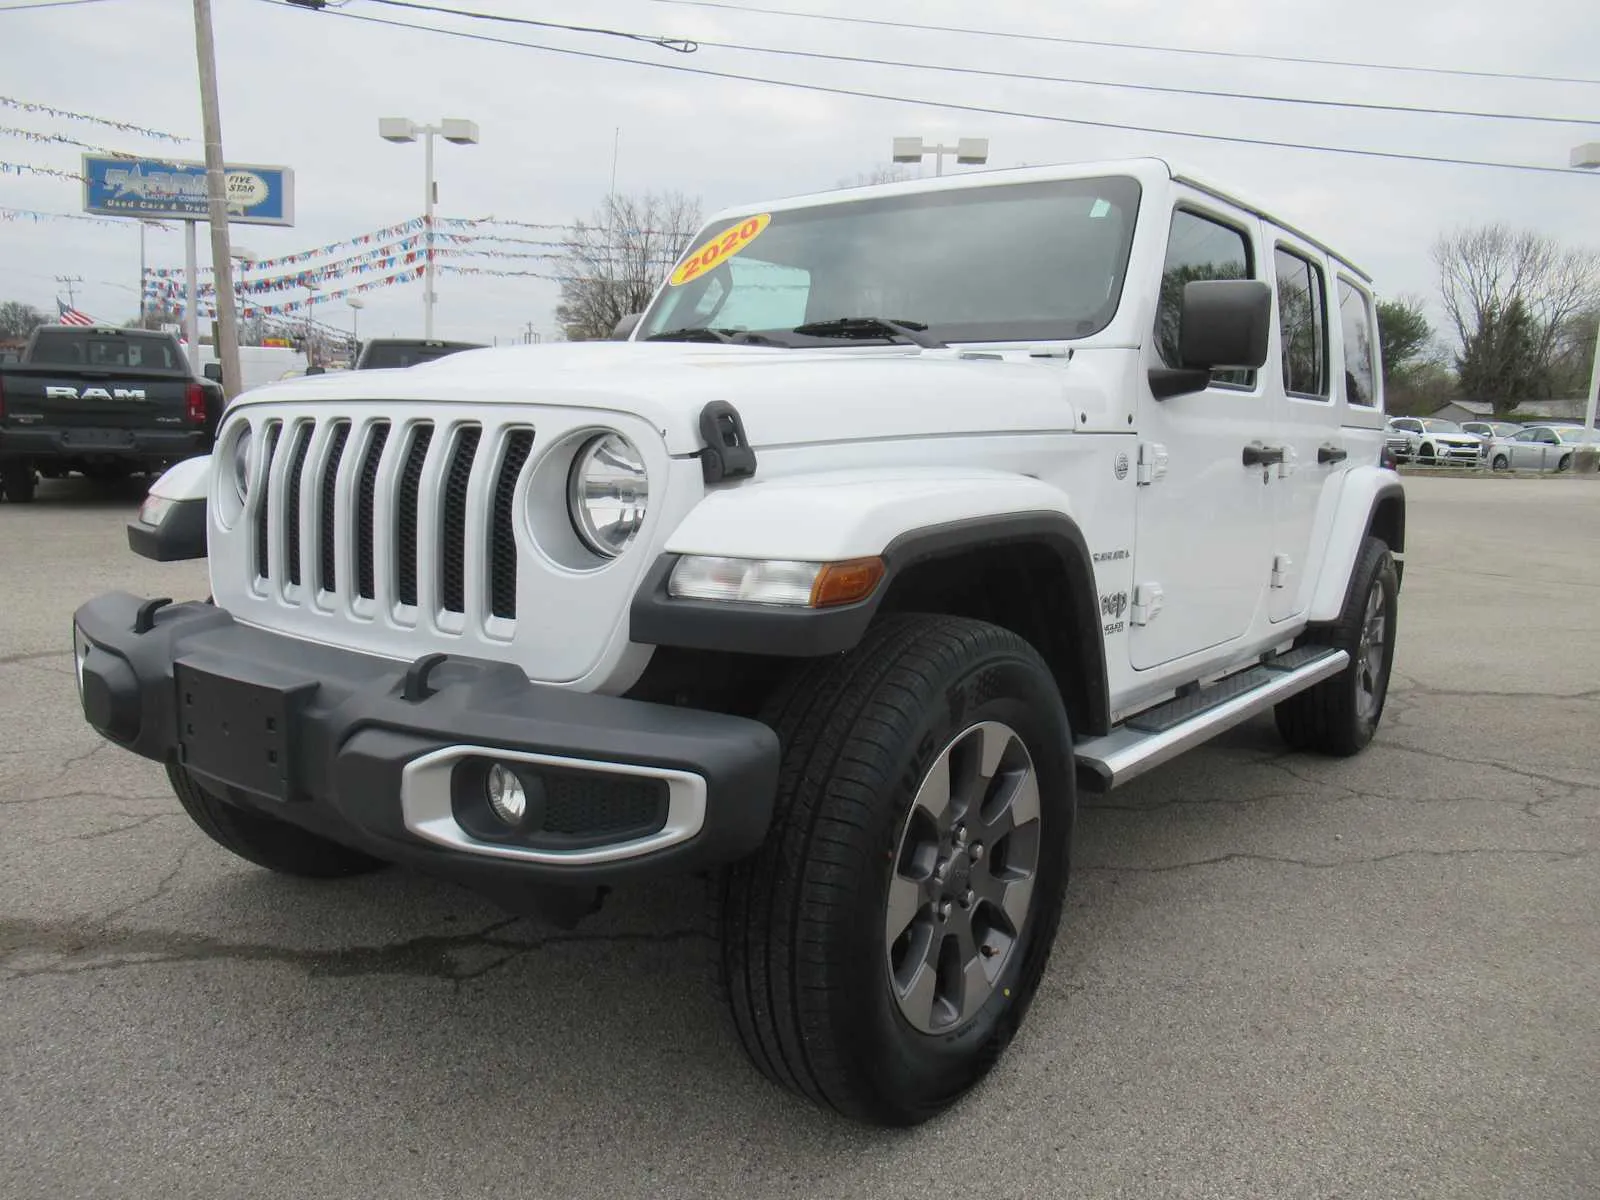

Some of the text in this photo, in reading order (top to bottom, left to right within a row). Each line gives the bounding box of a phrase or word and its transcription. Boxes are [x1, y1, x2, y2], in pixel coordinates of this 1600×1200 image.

[229, 175, 253, 183] FIVE
[229, 184, 255, 192] STAR
[107, 200, 134, 208] Used
[140, 202, 165, 210] Cars
[682, 219, 760, 280] 2020
[46, 386, 146, 400] RAM
